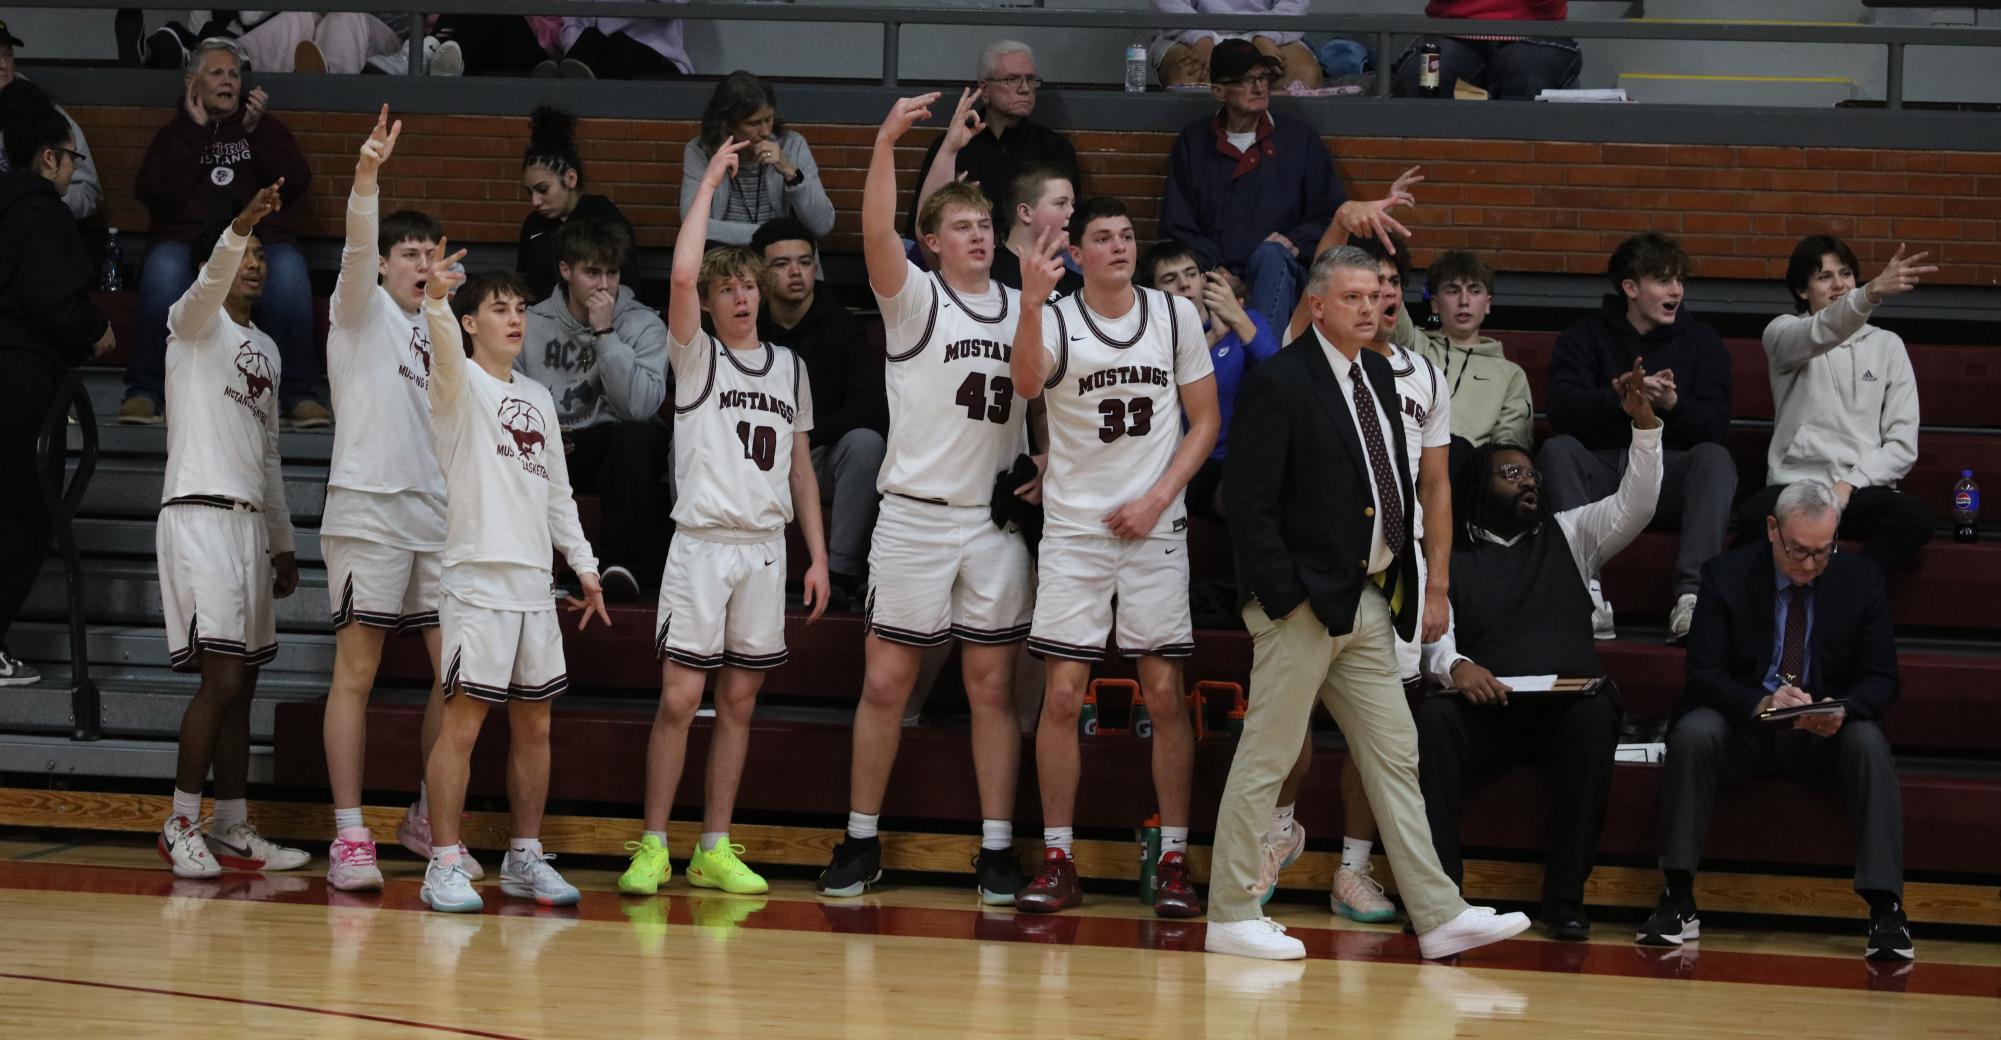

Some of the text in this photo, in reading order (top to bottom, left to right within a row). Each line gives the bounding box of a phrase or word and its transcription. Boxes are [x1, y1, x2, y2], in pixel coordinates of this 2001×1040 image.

[943, 338, 1012, 364] MUSTAN
[955, 371, 1014, 425] 43
[1078, 365, 1168, 397] MUSTANGS
[719, 389, 795, 425] MUSTANGS
[1098, 397, 1153, 443] 33
[736, 420, 777, 472] 10
